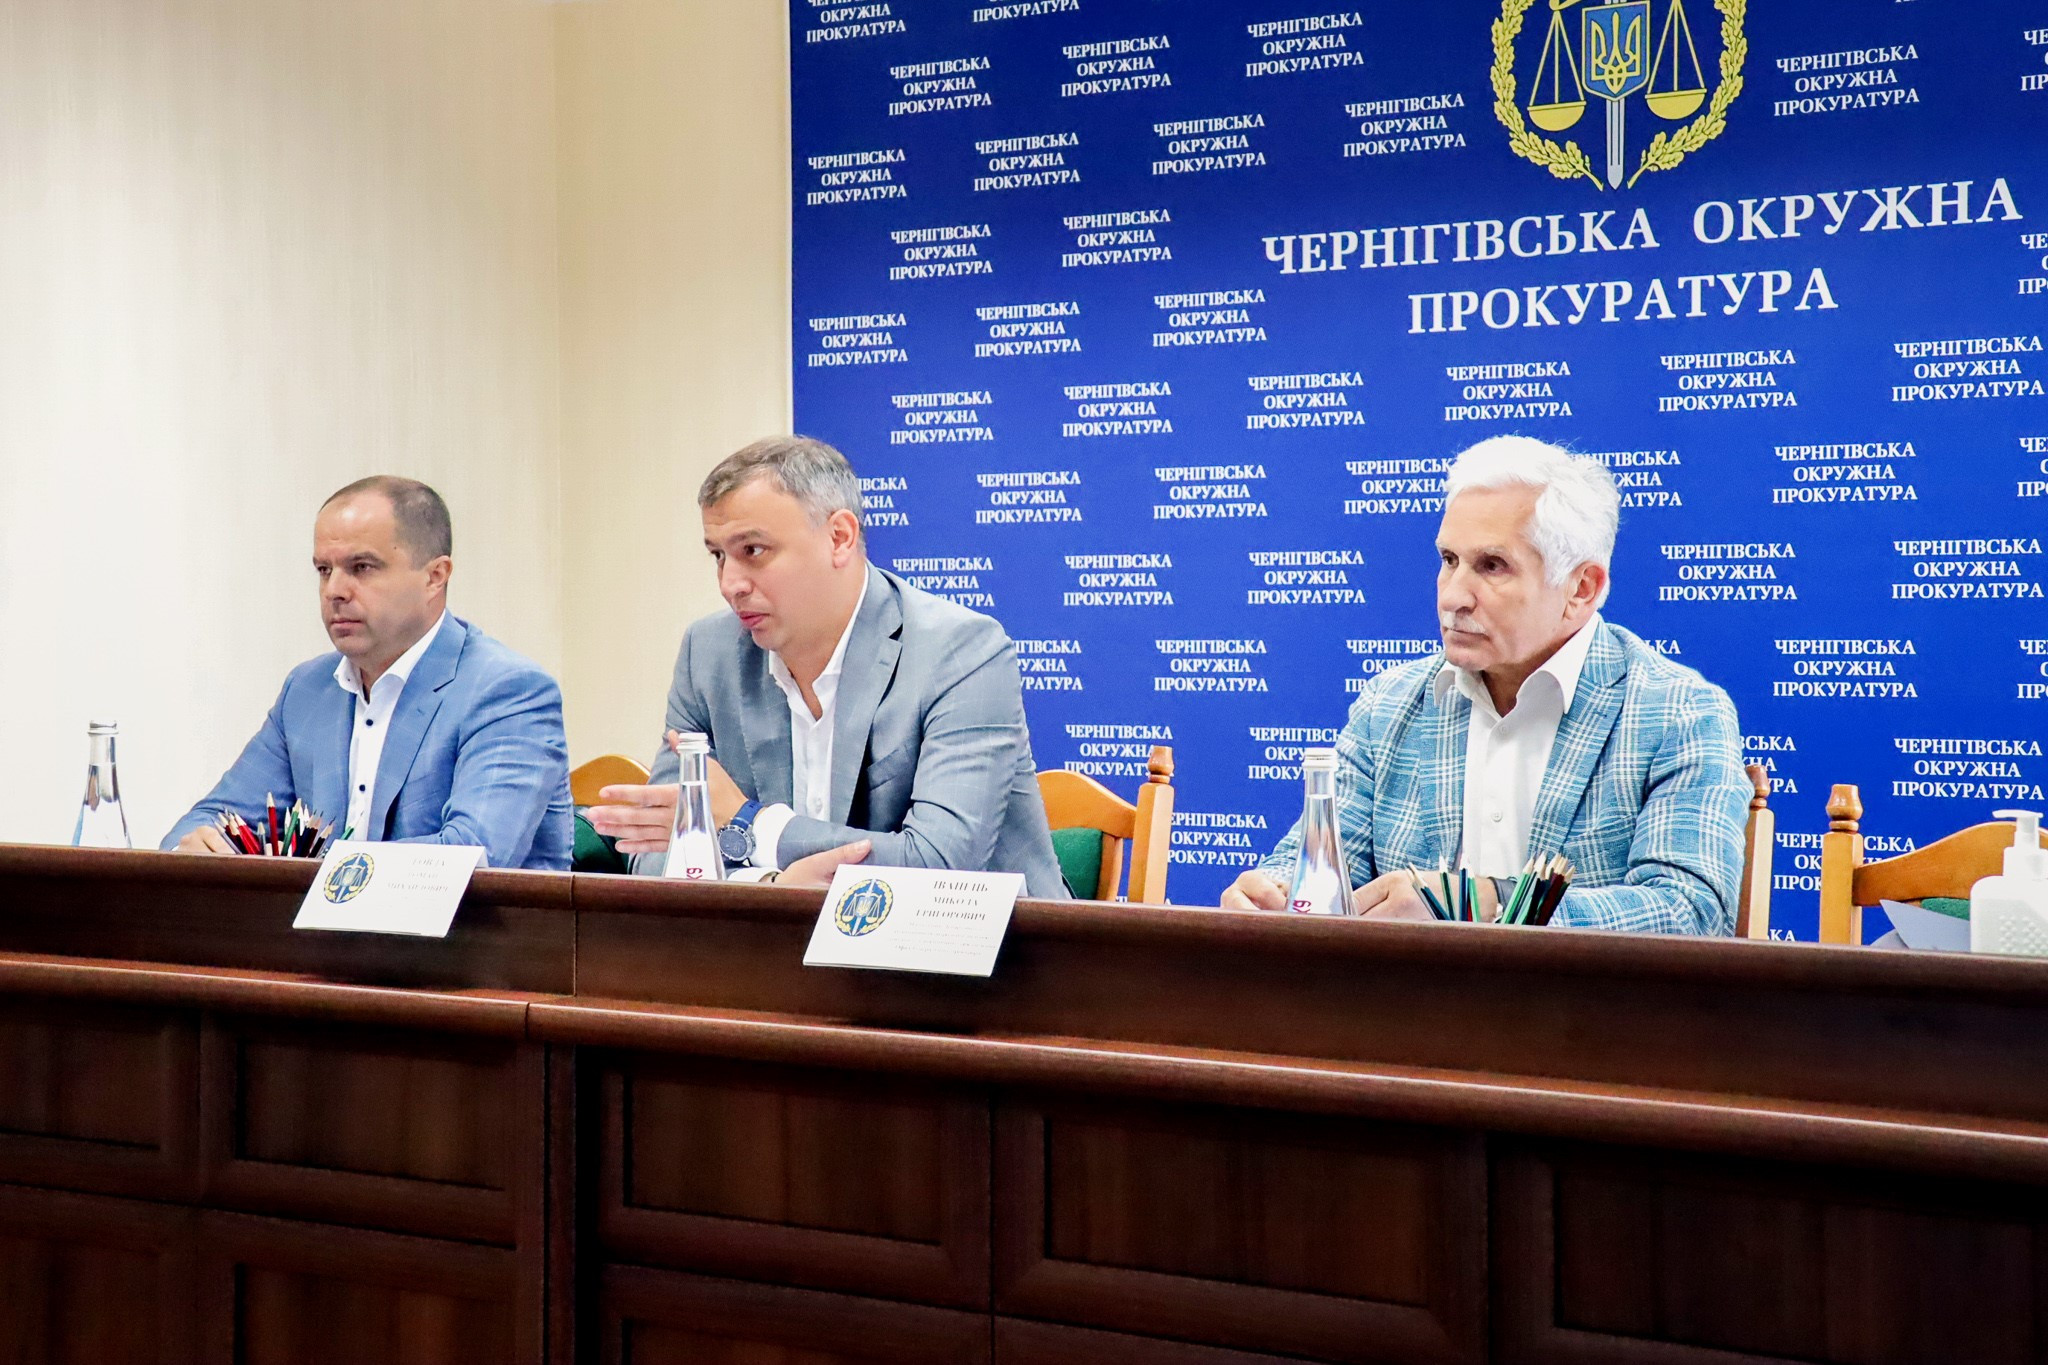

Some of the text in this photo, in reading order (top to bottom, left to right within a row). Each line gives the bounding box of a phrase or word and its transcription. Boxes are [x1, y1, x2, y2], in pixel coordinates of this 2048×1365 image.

[821, 4, 890, 22] ОКРУЖНА
[974, 0, 1079, 22] ПРОКУРАТУРА
[807, 20, 905, 42] ПРОКУРАТУРА
[1248, 13, 1362, 37] ЧЕРНІГІВСЬКА
[1063, 36, 1169, 58] ЧЕРНІГІВСЬКА
[1263, 34, 1345, 55] ОКРУЖНА
[1077, 57, 1154, 76] ОКРУЖНА
[1247, 52, 1363, 76] ПРОКУРАТУРА
[1777, 45, 1918, 72] ЧЕРНІГІВСЬКА
[891, 57, 990, 78] ЧЕРНІГІВСЬКА
[904, 77, 976, 95] ОКРУЖНА
[1062, 74, 1171, 96] ПРОКУРАТУРА
[1795, 69, 1897, 92] ОКРУЖНА
[890, 93, 991, 115] ПРОКУРАТУРА
[1346, 94, 1464, 117] ЧЕРНІГІВСЬКА
[1775, 89, 1919, 116] ПРОКУРАТУРА
[1154, 114, 1264, 136] ЧЕРНІГІВСЬКА
[1361, 115, 1447, 135] ОКРУЖНА
[976, 133, 1078, 154] ЧЕРНІГІВСЬКА
[1169, 135, 1248, 154] ОКРУЖНА
[1344, 134, 1465, 157] ПРОКУРАТУРА
[809, 149, 905, 169] ЧЕРНІГІВСЬКА
[989, 153, 1064, 171] ОКРУЖНА
[1153, 152, 1265, 174] ПРОКУРАТУРА
[822, 168, 891, 185] ОКРУЖНА
[975, 170, 1080, 191] ПРОКУРАТУРА
[808, 185, 906, 205] ПРОКУРАТУРА
[1064, 209, 1170, 229] ЧЕРНІГІВСЬКА
[1262, 177, 2024, 275] ЧЕРНІГІВСЬКА ОКРУЖНА
[891, 224, 991, 244] ЧЕРНІГІВСЬКА
[1078, 230, 1155, 247] ОКРУЖНА
[905, 244, 977, 260] ОКРУЖНА
[1063, 247, 1171, 267] ПРОКУРАТУРА
[890, 261, 992, 280] ПРОКУРАТУРА
[1154, 289, 1265, 309] ЧЕРНІГІВСЬКА
[1408, 267, 1839, 334] ПРОКУРАТУРА
[976, 302, 1080, 320] ЧЕРНІГІВСЬКА
[1169, 310, 1250, 327] ОКРУЖНА
[809, 314, 906, 331] ЧЕРНІГІВСЬКА
[990, 321, 1065, 338] ОКРУЖНА
[822, 332, 892, 348] ОКРУЖНА
[1153, 327, 1266, 347] ПРОКУРАТУРА
[975, 339, 1081, 357] ПРОКУРАТУРА
[1894, 336, 2043, 358] ЧЕРНІГІВСЬКА
[809, 349, 908, 366] ПРОКУРАТУРА
[1661, 350, 1796, 370] ЧЕРНІГІВСЬКА
[1446, 362, 1570, 381] ЧЕРНІГІВСЬКА
[1914, 359, 2021, 378] ОКРУЖНА
[1248, 372, 1363, 391] ЧЕРНІГІВСЬКА
[1679, 372, 1776, 390] ОКРУЖНА
[1064, 382, 1171, 400] ЧЕРНІГІВСЬКА
[1463, 383, 1553, 400] ОКРУЖНА
[1892, 380, 2044, 401] ПРОКУРАТУРА
[892, 391, 992, 408] ЧЕРНІГІВСЬКА
[1264, 392, 1347, 409] ОКРУЖНА
[1659, 392, 1797, 411] ПРОКУРАТУРА
[905, 410, 978, 425] ОКРУЖНА
[1078, 401, 1156, 417] ОКРУЖНА
[1445, 402, 1572, 421] ПРОКУРАТУРА
[1063, 419, 1173, 437] ПРОКУРАТУРА
[1247, 411, 1365, 429] ПРОКУРАТУРА
[891, 427, 993, 444] ПРОКУРАТУРА
[1775, 442, 1916, 461] ЧЕРНІГІВСЬКА
[1155, 465, 1266, 481] ЧЕРНІГІВСЬКА
[1345, 458, 1452, 475] ЧЕРНІГІВСЬК
[1794, 464, 1895, 481] ОКРУЖНА
[859, 477, 908, 491] ІВСЬКА
[977, 471, 1081, 487] ЧЕРНІГІВСЬКА
[991, 490, 1066, 505] ОКРУЖНА
[1170, 484, 1250, 500] ОКРУЖНА
[1773, 485, 1917, 503] ПРОКУРАТУРА
[1154, 503, 1267, 519] ПРОКУРАТУРА
[1344, 497, 1445, 514] ПРОКУРАТУ
[976, 508, 1082, 524] ПРОКУРАТУРА
[1661, 543, 1795, 559] ЧЕРНІГІВСЬКА
[1894, 539, 2042, 555] ЧЕРНІГІВСЬКА
[893, 557, 993, 571] ЧЕРНІГІВСЬКА
[1065, 554, 1172, 569] ЧЕРНІГІВСЬКА
[1249, 551, 1364, 566] ЧЕРНІГІВСЬКА
[1264, 570, 1348, 585] ОКРУЖНА
[1679, 565, 1776, 580] ОКРУЖНА
[1914, 561, 2021, 577] ОКРУЖНА
[906, 575, 980, 589] ОКРУЖНА
[1079, 573, 1157, 587] ОКРУЖНА
[1064, 592, 1173, 606] ПРОКУРАТУРА
[1248, 590, 1365, 604] ПРОКУРАТУРА
[1659, 585, 1797, 600] ПРОКУРАТУРА
[1892, 583, 2044, 598] ПРОКУРАТУРА
[1012, 639, 1082, 654] ІГІВСЬКА
[1155, 640, 1267, 653] ЧЕРНІГІВСЬКА
[1346, 639, 1446, 654] ЧЕРНІГІВСЬ
[1775, 640, 1916, 654] ЧЕРНІГІВСЬКА
[1170, 659, 1251, 672] ОКРУЖНА
[1794, 661, 1896, 675] ОКРУЖНА
[1154, 677, 1268, 691] ПРОКУРАТУРА
[1774, 682, 1917, 697] ПРОКУРАТУРА
[1066, 725, 1173, 739] ЧЕРНІГІВСЬКА
[1250, 727, 1341, 742] ЧЕРНІГІВСЬ
[1265, 746, 1305, 761] ОКРУ
[1894, 739, 2042, 755] ЧЕРНІГІВСЬКА
[1064, 761, 1174, 777] ПРОКУРАТУ
[1914, 760, 2021, 777] ОКРУЖНА
[1893, 781, 2044, 800] ПРОКУРАТУРА
[1171, 812, 1267, 829] ЕРНІГІВСЬКА
[1171, 831, 1252, 847] ОКРУЖНА
[1168, 849, 1266, 867] РОКУРАТУРА
